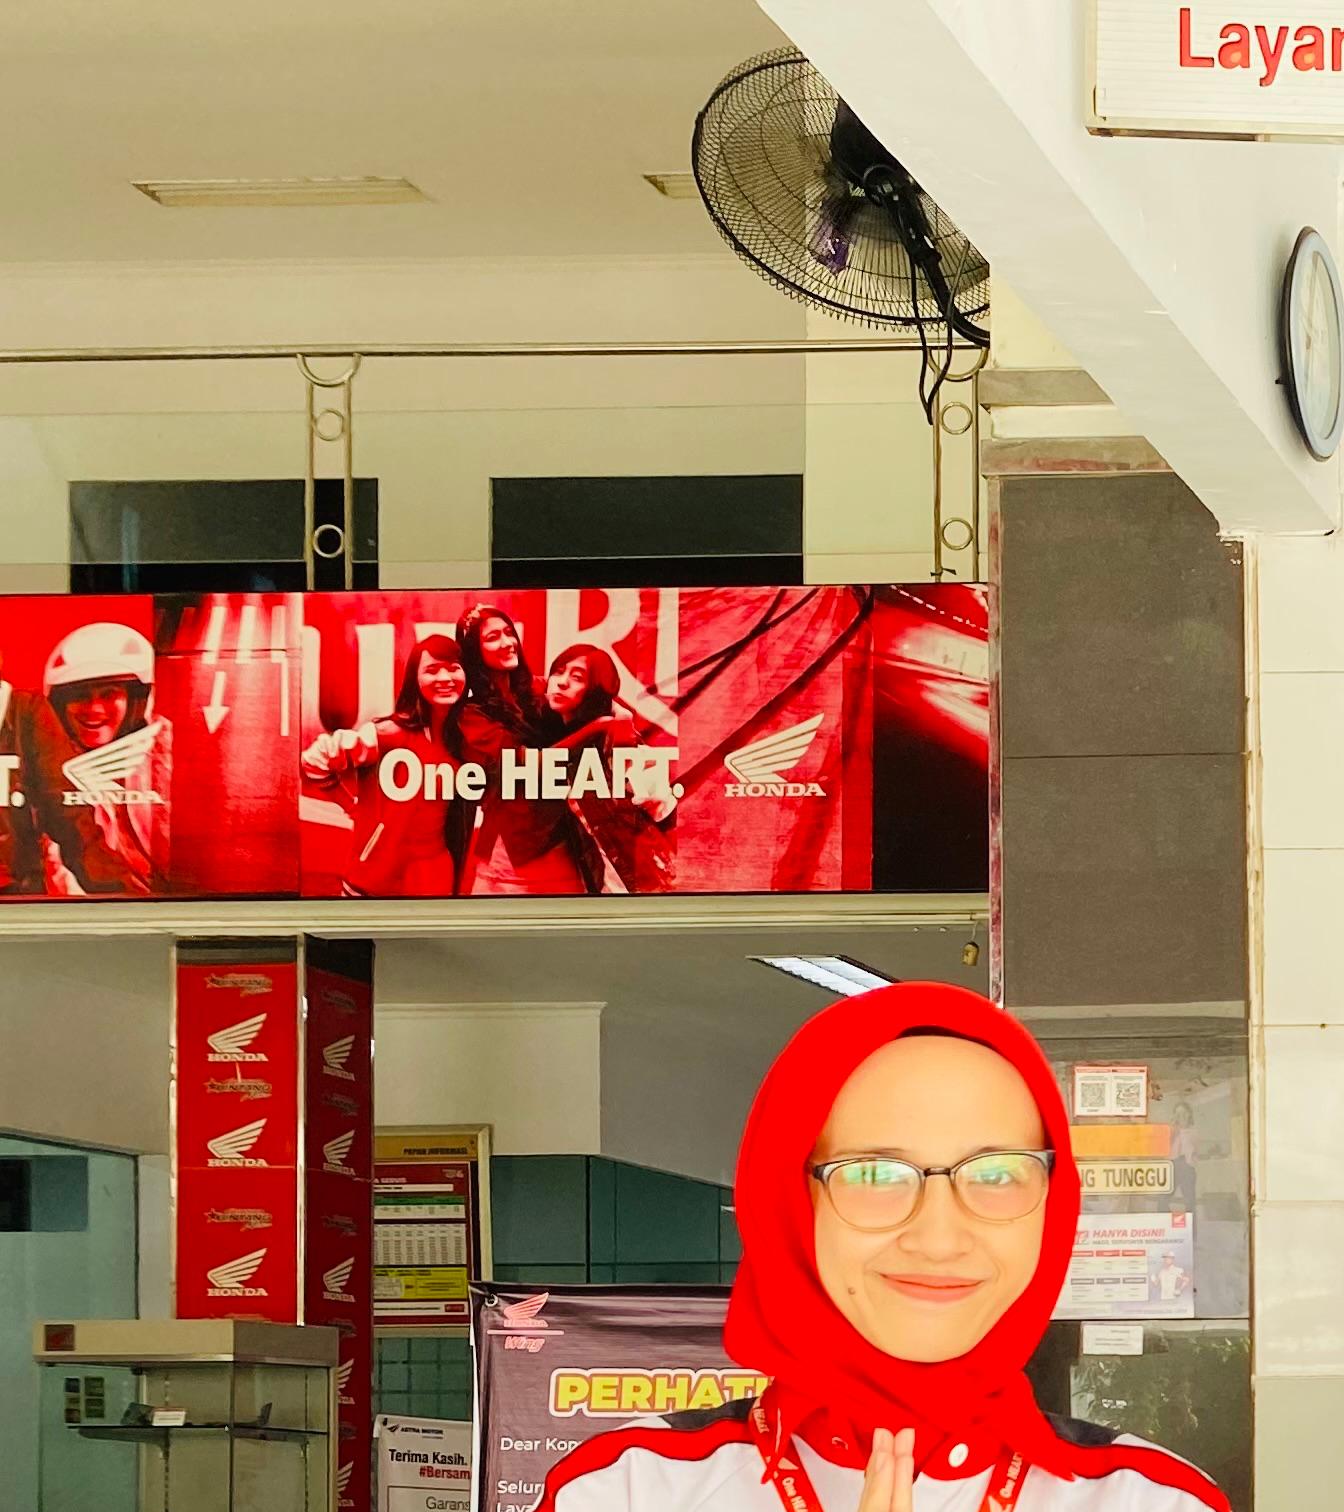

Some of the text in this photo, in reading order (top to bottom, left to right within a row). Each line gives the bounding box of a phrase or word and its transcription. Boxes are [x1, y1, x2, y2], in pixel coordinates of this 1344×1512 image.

[378, 746, 685, 801] One HEART.
[723, 782, 827, 797] HONDA
[62, 790, 166, 806] HONDA
[207, 1053, 269, 1062] HONDA
[207, 1158, 269, 1168] HONDA
[1103, 1167, 1167, 1187] TUNGGU
[207, 1287, 269, 1297] HONDA
[500, 1437, 541, 1451] Dear
[389, 1448, 468, 1466] Terima Kasih.
